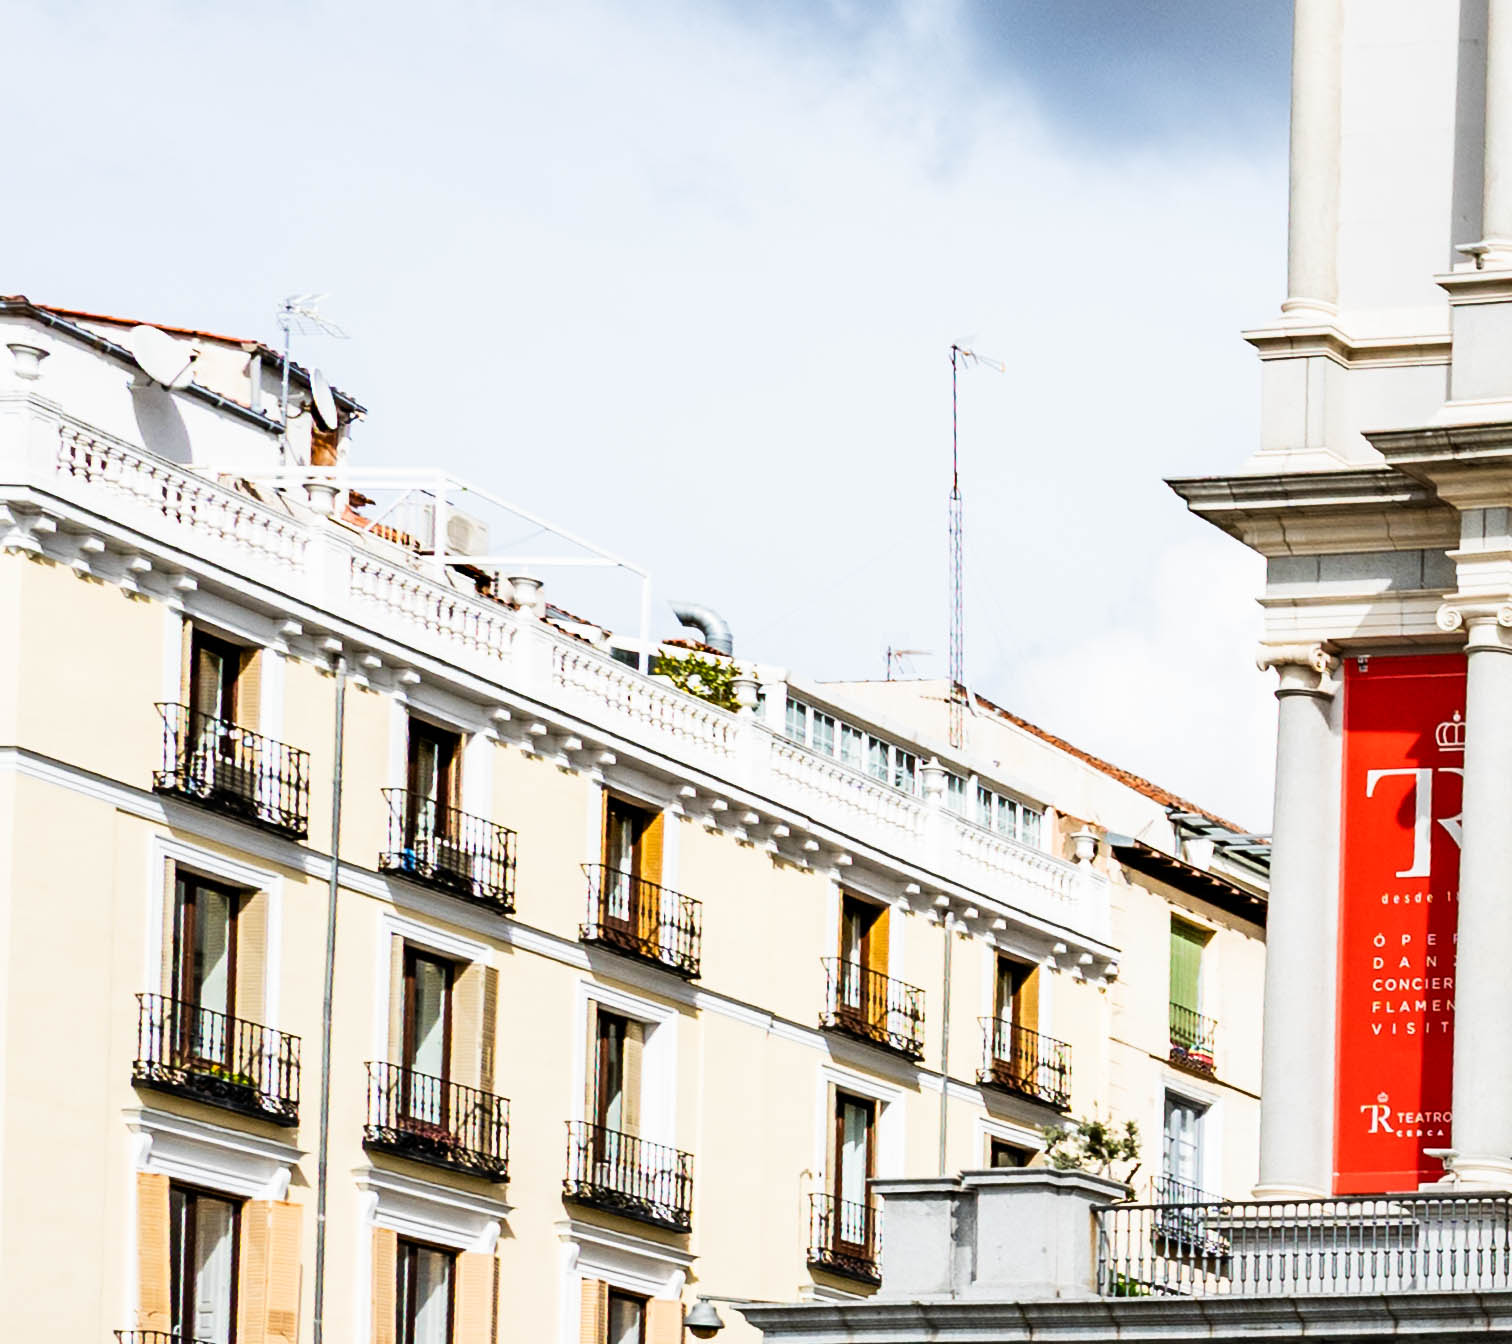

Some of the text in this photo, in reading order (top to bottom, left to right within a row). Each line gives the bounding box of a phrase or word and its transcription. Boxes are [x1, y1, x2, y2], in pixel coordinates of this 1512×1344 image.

[1381, 891, 1433, 904] desde
[1372, 977, 1454, 992] CONCIER
[1372, 999, 1456, 1014] FLAMEN
[1371, 1021, 1450, 1036] VISIT
[1360, 1104, 1453, 1134] TR TEATRO
